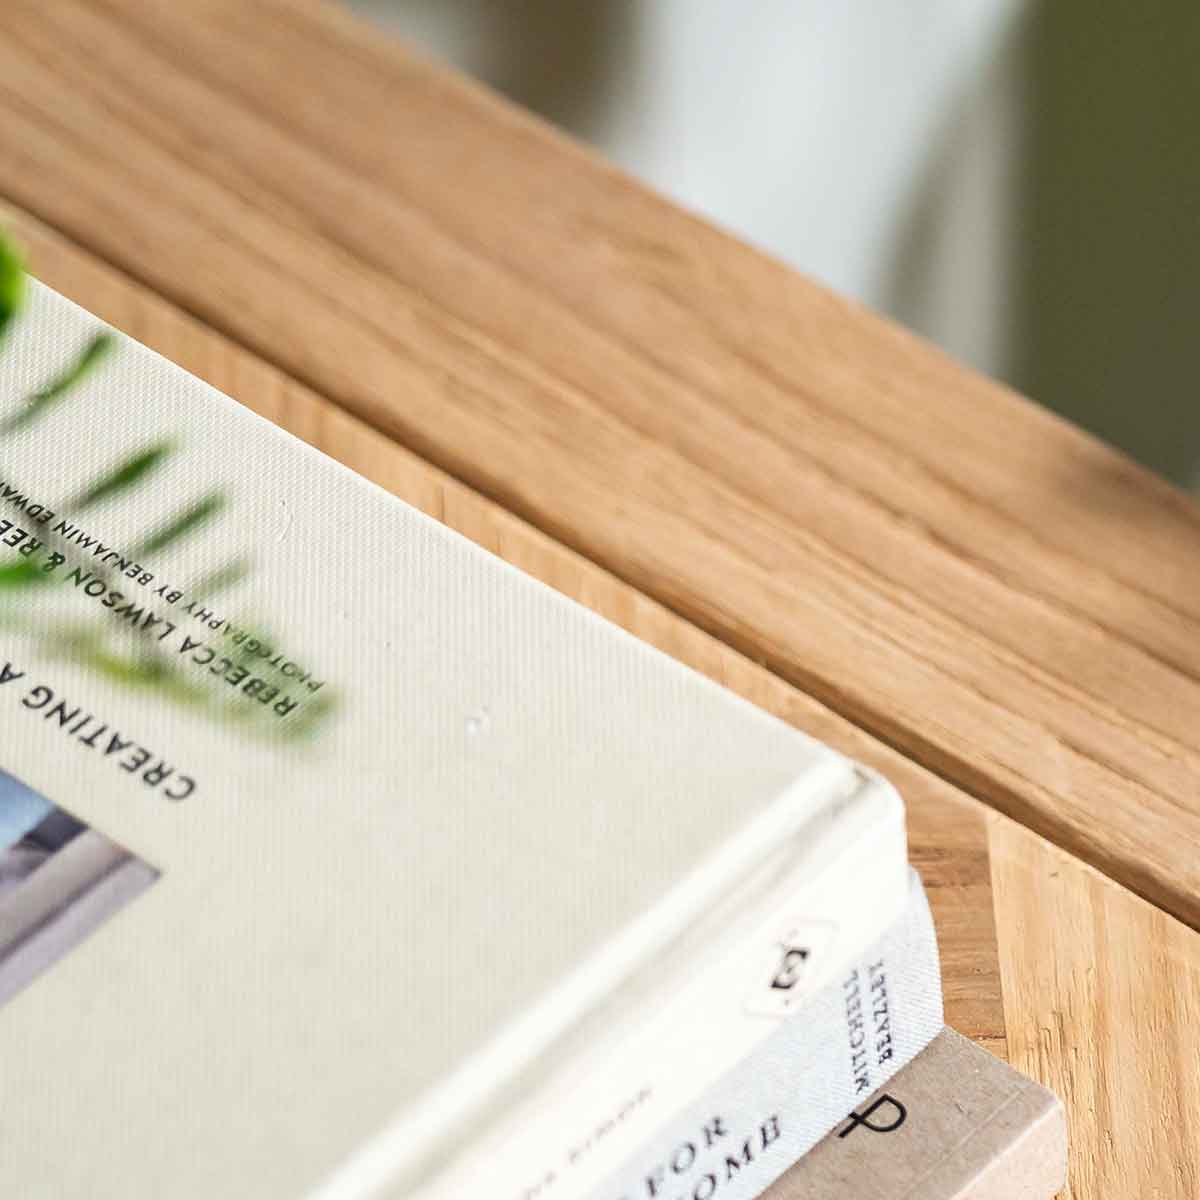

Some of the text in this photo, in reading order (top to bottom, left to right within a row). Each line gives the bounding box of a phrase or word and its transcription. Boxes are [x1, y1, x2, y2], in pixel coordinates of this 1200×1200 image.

[0, 482, 56, 524] EDWA
[42, 551, 66, 573] &
[53, 520, 155, 586] BENJAMIN
[63, 567, 176, 641] LAWSON
[154, 584, 184, 604] BY
[178, 635, 299, 716] REBECCA
[21, 685, 197, 801] CREATING
[644, 1115, 729, 1198] FOR
